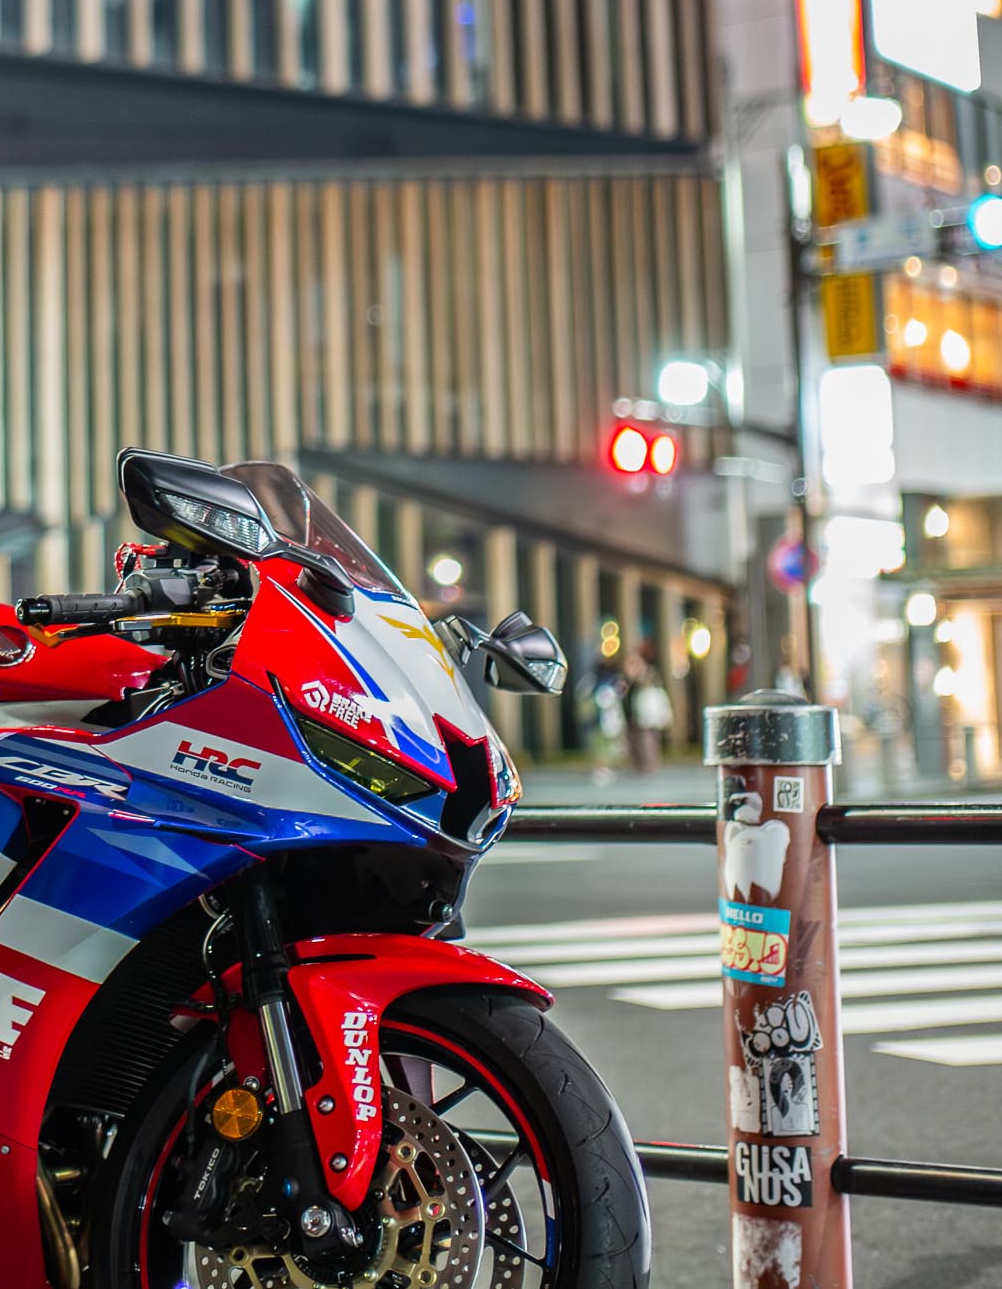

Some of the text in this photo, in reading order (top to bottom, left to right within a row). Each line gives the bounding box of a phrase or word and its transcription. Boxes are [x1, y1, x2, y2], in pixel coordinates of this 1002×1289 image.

[328, 705, 358, 730] FREE
[169, 763, 252, 793] Honda RACING
[172, 739, 262, 787] HRC
[725, 906, 764, 924] HELLO
[341, 1012, 377, 1121] DUNLOP
[193, 1148, 220, 1200] TOKICO
[736, 1142, 812, 1183] GUSA
[744, 1169, 803, 1207] NUS
